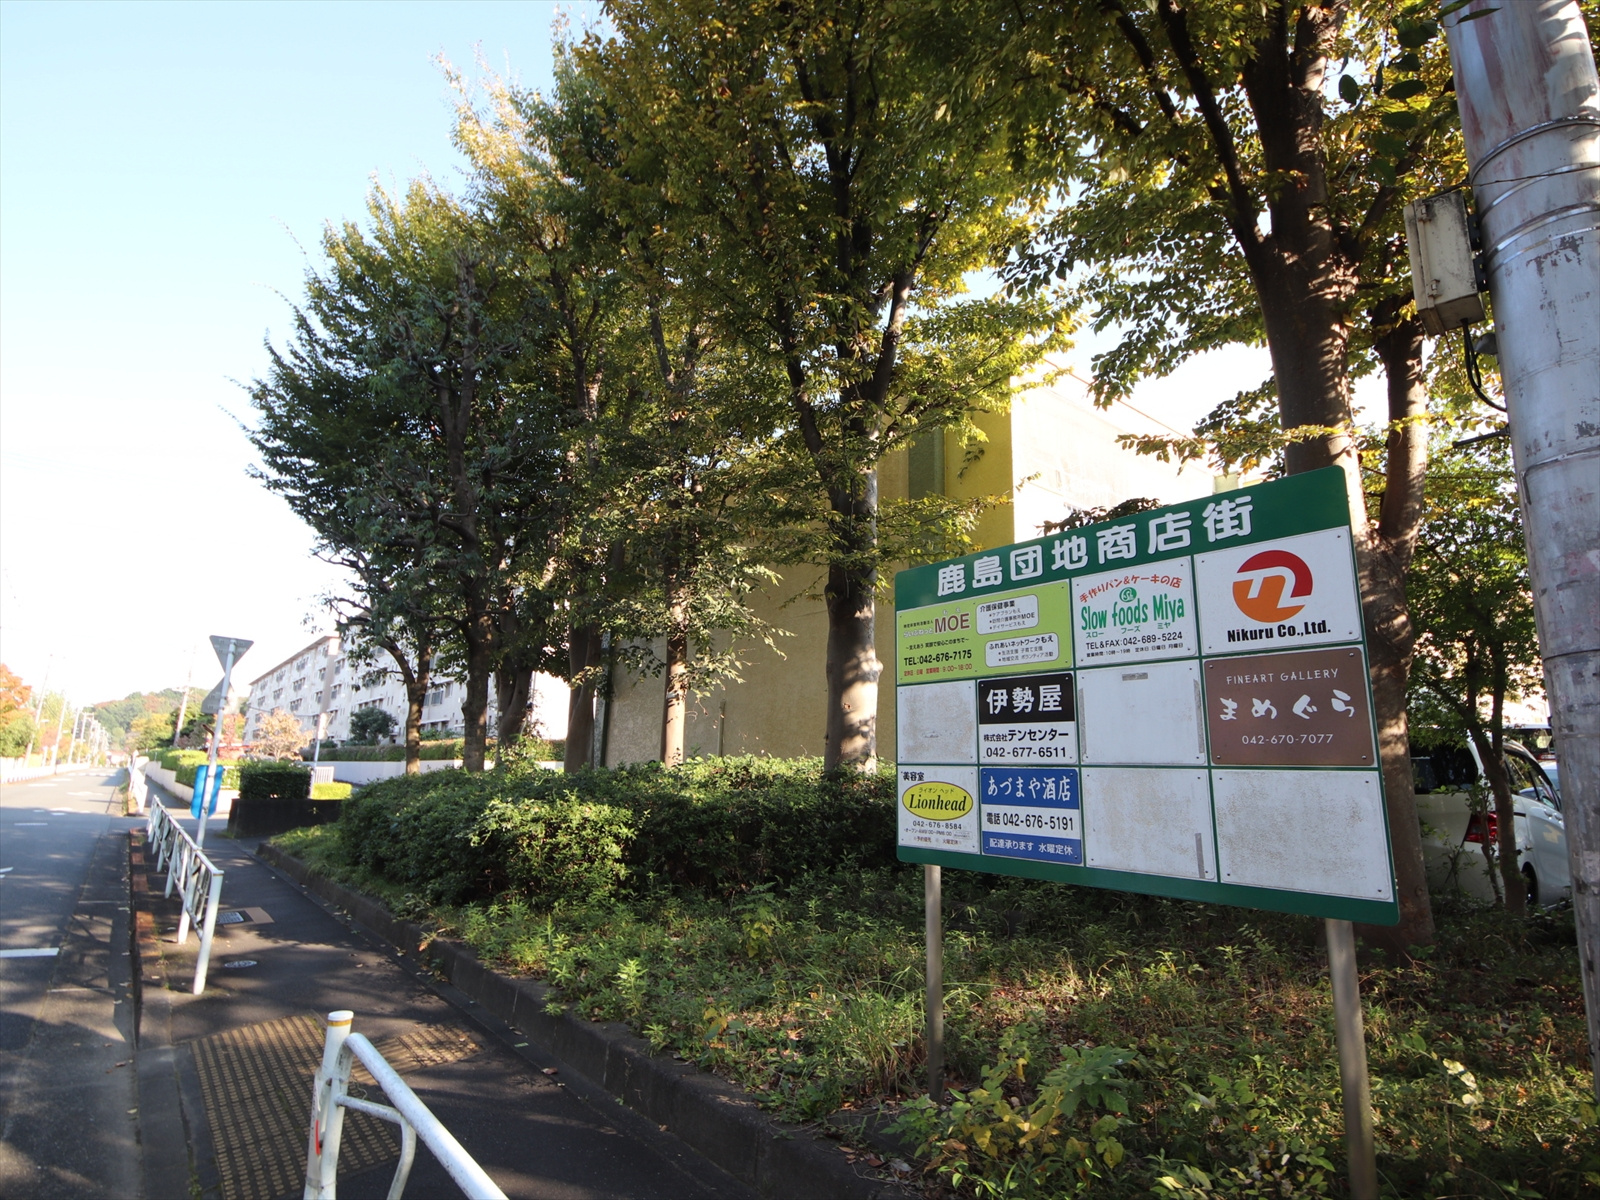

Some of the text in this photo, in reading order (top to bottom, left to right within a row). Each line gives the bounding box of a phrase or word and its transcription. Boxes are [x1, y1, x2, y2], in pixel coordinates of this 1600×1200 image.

[937, 495, 1253, 597] 鹿島団地商店街
[1079, 574, 1182, 603] 手作りパン&ケーキの店
[1081, 593, 1184, 631] Slow foods Miya
[934, 612, 970, 634] MOE
[1086, 621, 1171, 639] スロー フーズ ミヤ
[1227, 619, 1331, 643] Nikuru Co.,Ltd.
[989, 634, 1054, 650] ふれあいネットワークもえ
[1086, 631, 1183, 650] TEL&FAX:042-689-5224
[904, 649, 972, 666] TEL:042-676-7175
[1226, 668, 1338, 685] FINEART GALLERY
[986, 684, 1062, 715] 伊勢屋
[1219, 689, 1355, 721] まめぐら
[983, 728, 1069, 742] 株式会社テンセンター
[1241, 733, 1334, 745] 042-670-7077
[986, 746, 1066, 758] 042-677-6511
[903, 771, 925, 781] 美容室
[987, 775, 1071, 801] あづまや酒店
[909, 794, 967, 811] Lionhead
[986, 812, 1074, 831] 電話 042-676-5191
[1038, 842, 1073, 856] 水曜定休
